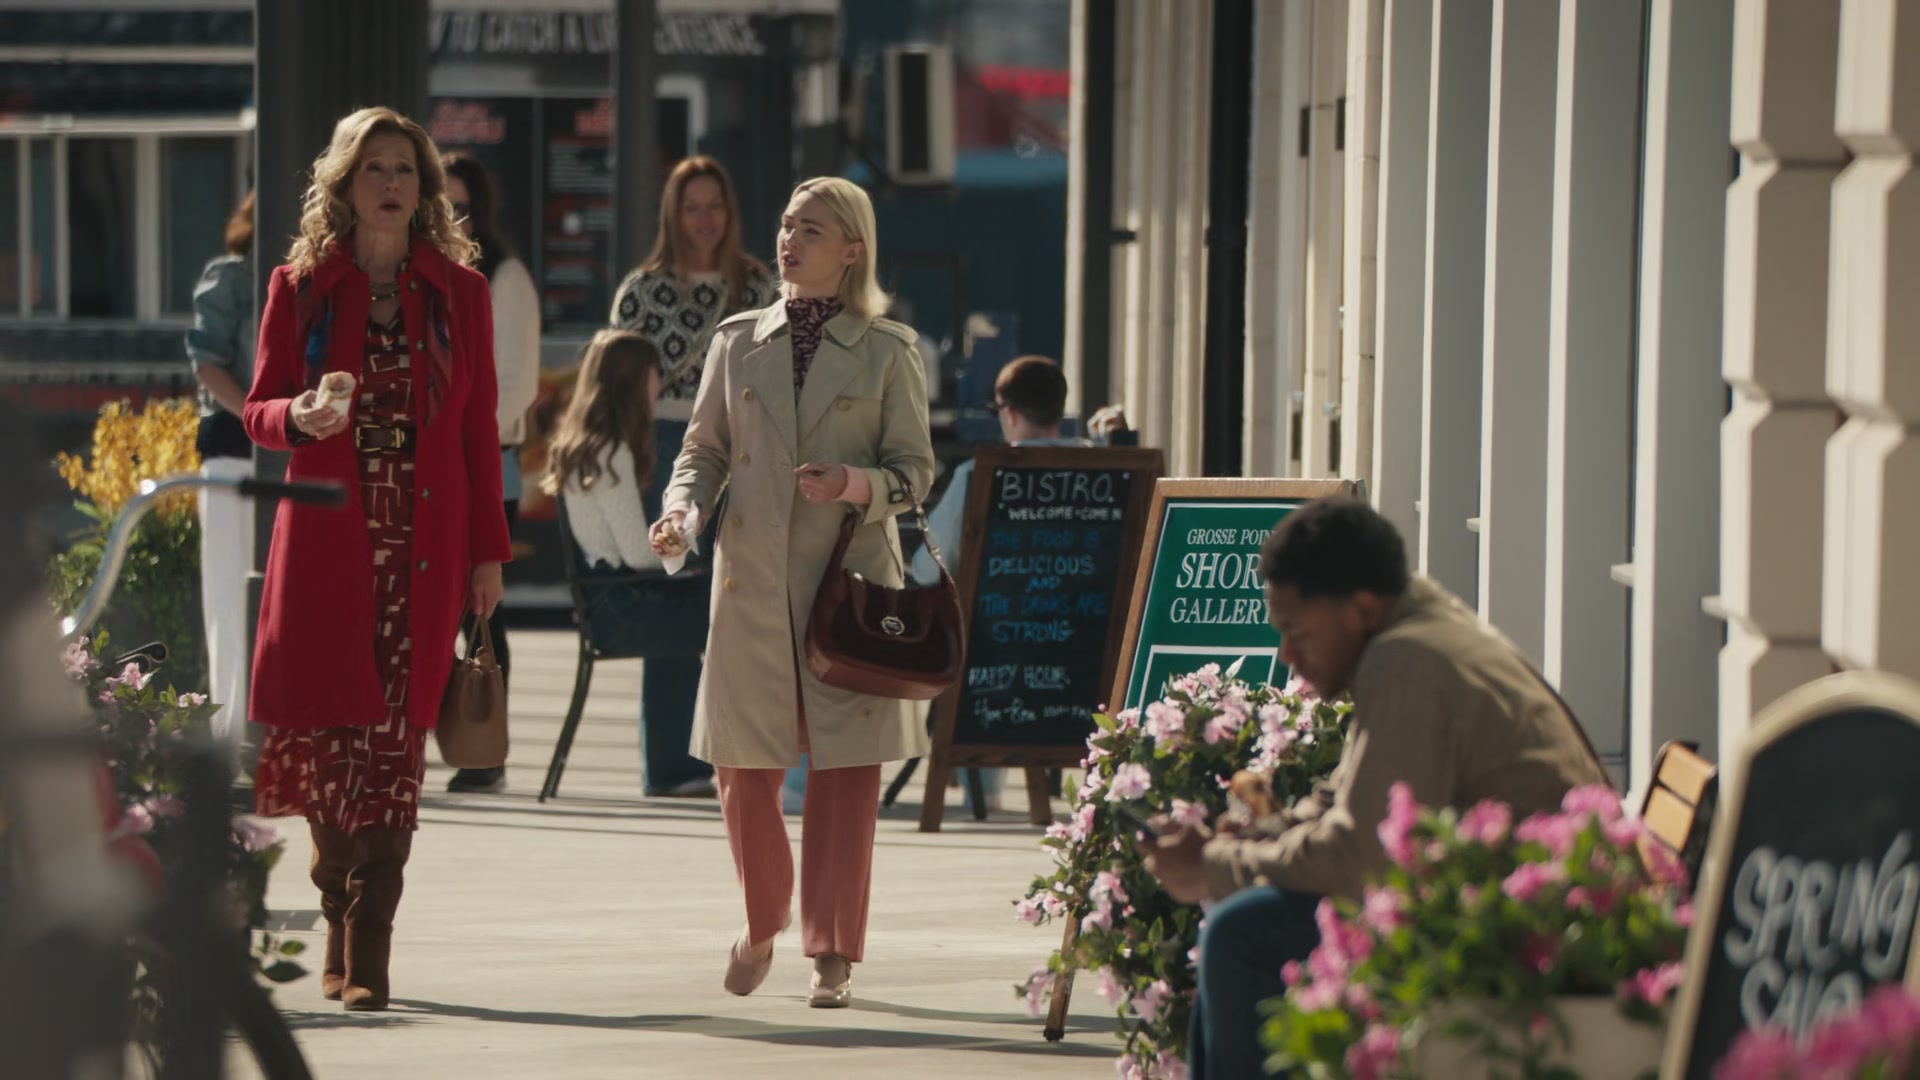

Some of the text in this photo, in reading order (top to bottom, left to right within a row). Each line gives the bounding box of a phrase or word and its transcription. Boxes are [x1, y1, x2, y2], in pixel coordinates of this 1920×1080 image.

[652, 15, 764, 56] ENTENCE
[1008, 506, 1074, 520] WELCOME
[1187, 528, 1237, 545] GROSSE
[988, 555, 1097, 577] DELICIOUS
[1176, 552, 1270, 590] SHOR
[1025, 576, 1063, 593] AND
[991, 619, 1076, 644] STRONG
[968, 664, 1072, 689] HAPPY HOUR
